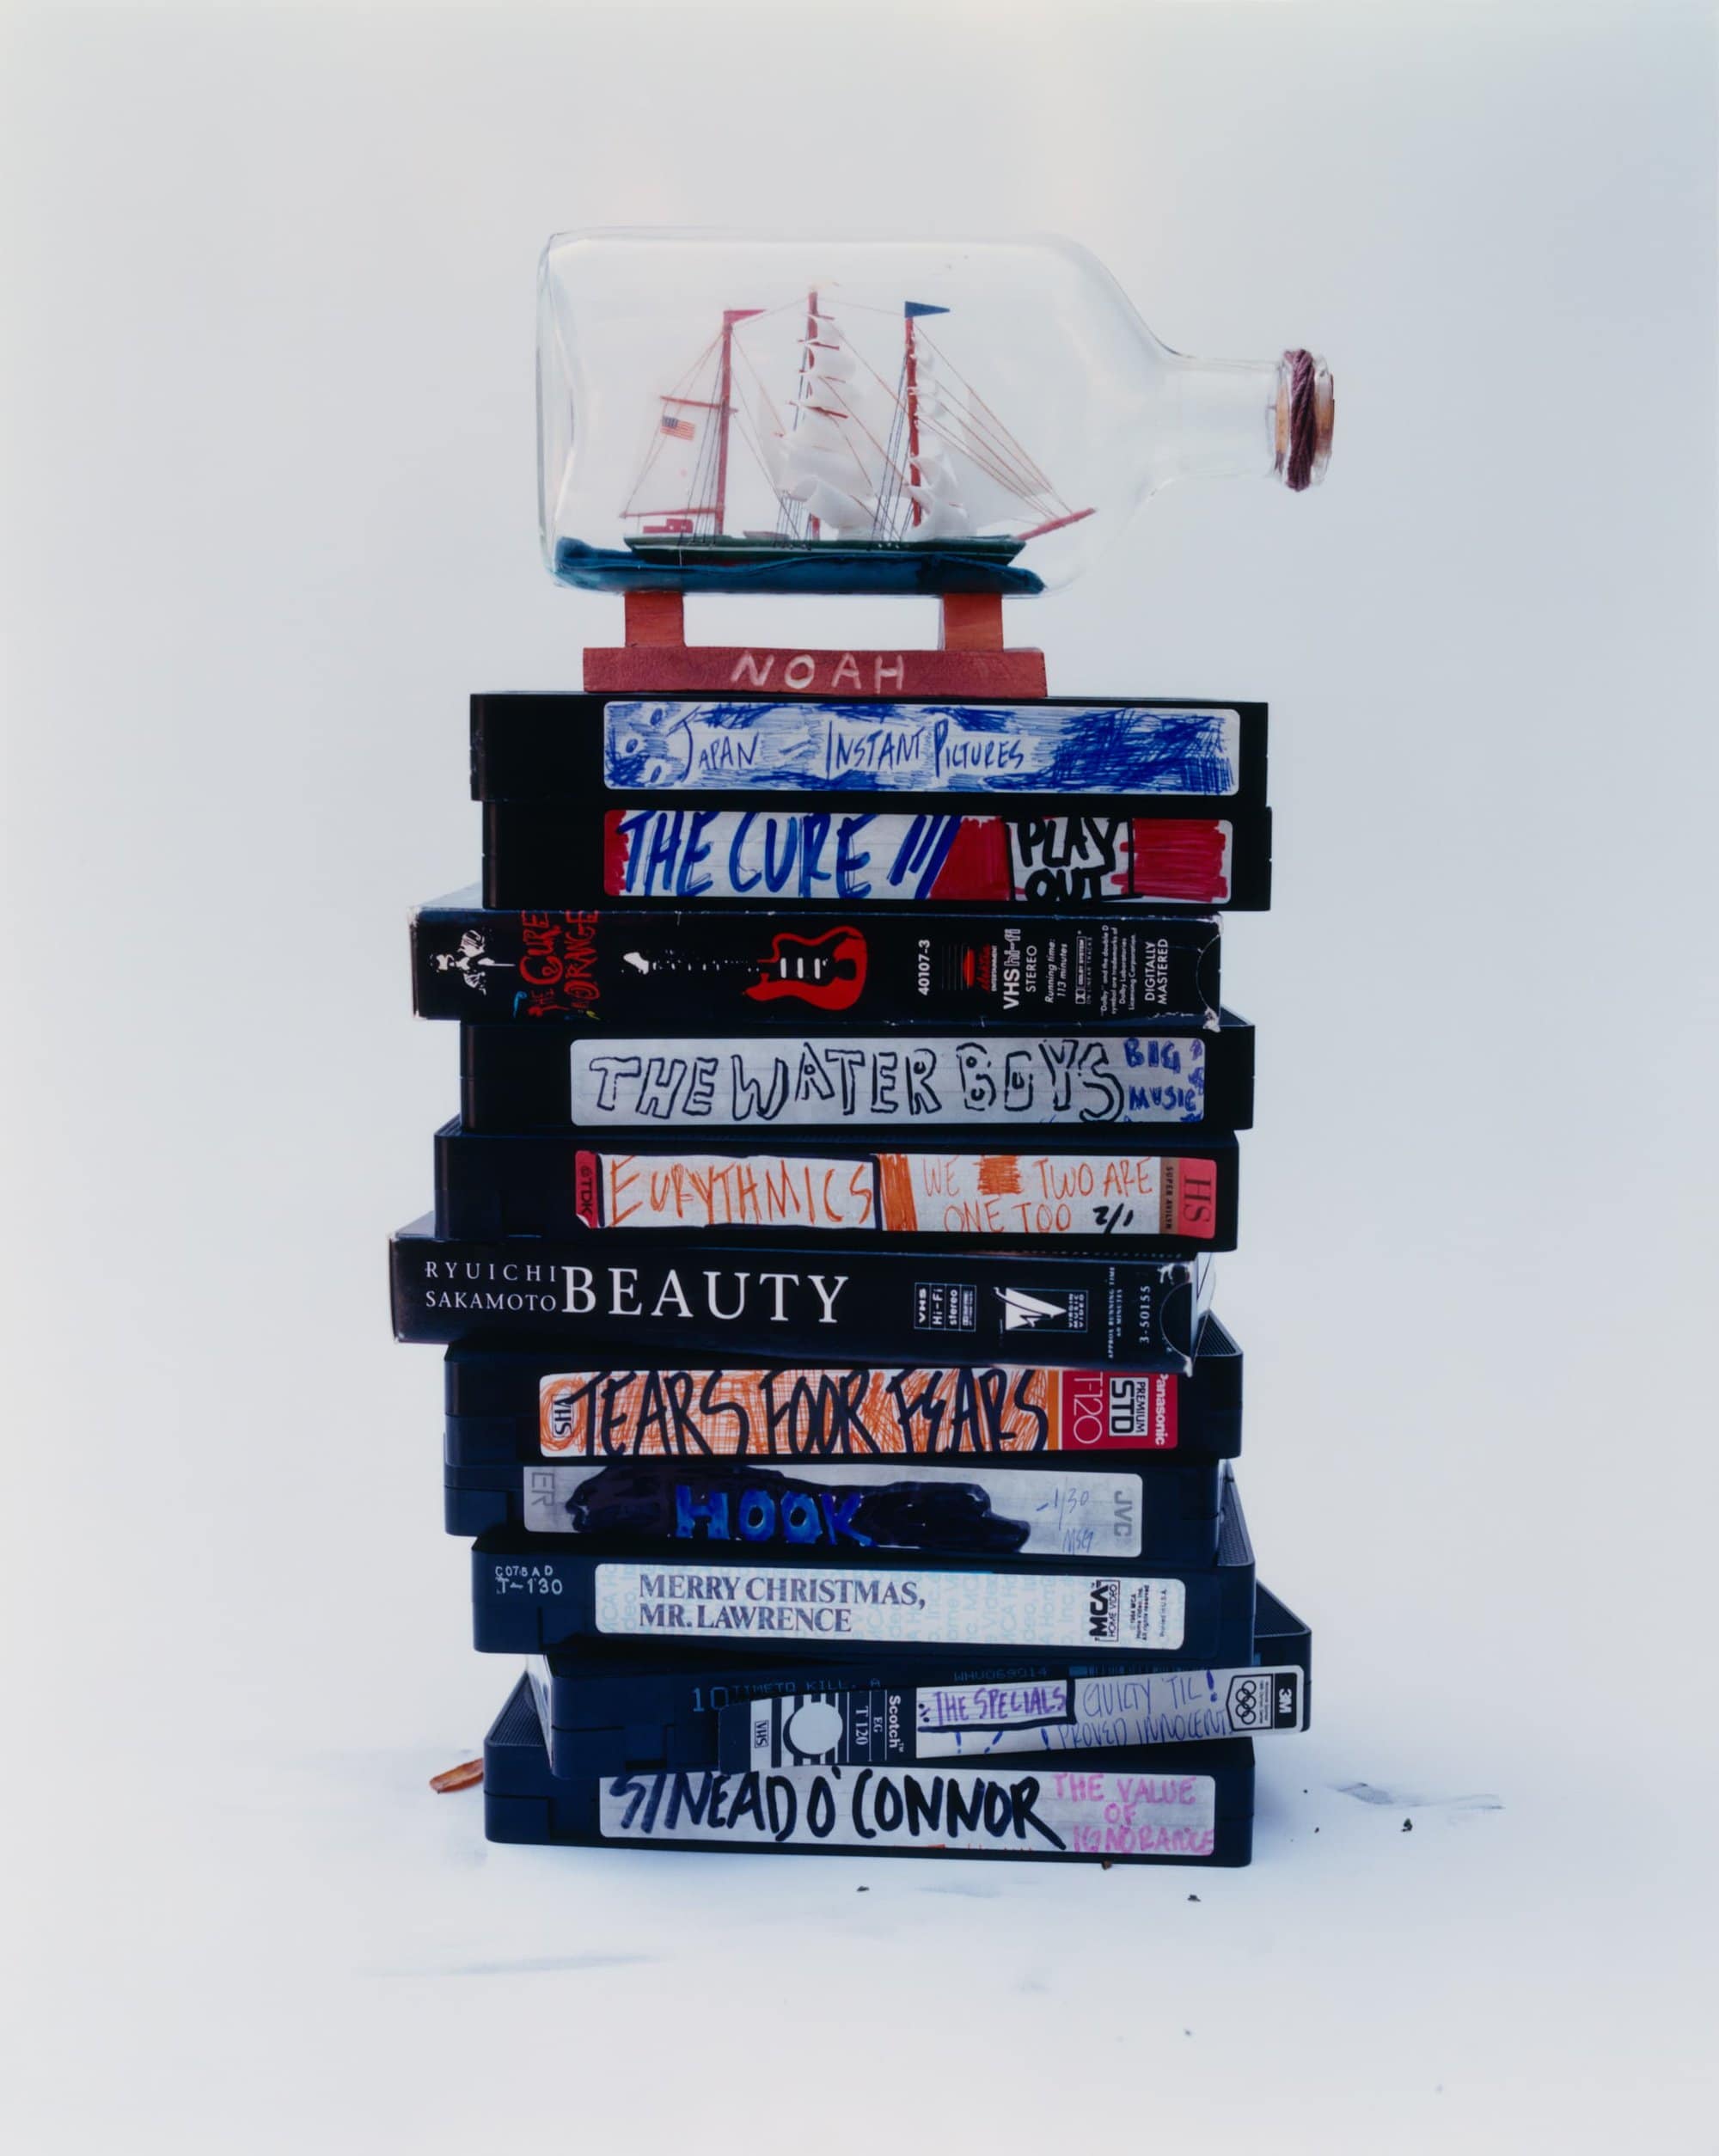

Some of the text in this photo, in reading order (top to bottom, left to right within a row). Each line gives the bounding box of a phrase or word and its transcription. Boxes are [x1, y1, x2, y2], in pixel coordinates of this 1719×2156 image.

[731, 651, 903, 695] NOAH
[826, 720, 926, 781] INSTANT
[933, 718, 1025, 778] PICTURES
[616, 810, 881, 898] THE CURE
[1015, 816, 1123, 873] PLAY
[1024, 867, 1110, 902] OUT
[918, 940, 931, 996] 40107-3
[1003, 969, 1020, 1010] VHS
[1025, 945, 1037, 993] STEREO
[1044, 965, 1058, 1003] Running
[1057, 943, 1068, 997] 113 minutes
[1145, 941, 1156, 1001] DIGITALLY
[1158, 939, 1168, 1005] MASTERED
[1123, 1038, 1181, 1074] BIG
[590, 1057, 719, 1119] THE
[1129, 1085, 1197, 1112] MUSIC
[581, 1178, 593, 1215] TDK
[922, 1156, 1153, 1200] WE TWO ARE
[1184, 1175, 1213, 1223] HS
[943, 1196, 1072, 1233] ONE TOO
[425, 1261, 556, 1283] RYUICHI
[560, 1265, 849, 1323] BEAUTY
[425, 1290, 557, 1312] SAKAMOTO
[932, 1289, 943, 1326] Hi-Fi
[948, 1289, 958, 1326] stereo
[1139, 1285, 1151, 1344] 3-50155
[554, 1397, 573, 1436] VHS
[555, 1370, 749, 1457] TEARS
[1074, 1371, 1104, 1444] T-120
[1111, 1380, 1135, 1434] STD
[1135, 1381, 1146, 1433] PREMIUM
[676, 1485, 877, 1547] HOOK
[1113, 1490, 1133, 1537] JVC
[639, 1574, 741, 1602] MERRY
[745, 1576, 927, 1610] CHRISTMAS,
[1089, 1584, 1109, 1637] MCA
[1109, 1583, 1117, 1609] VIDEO
[639, 1603, 693, 1628] MR.
[696, 1605, 852, 1632] LAWRENCE
[933, 1686, 1067, 1726] THE SPECIALS
[1083, 1678, 1152, 1718] GUILTY
[1279, 1687, 1293, 1713] 3M
[756, 1720, 768, 1748] VHS
[873, 1716, 883, 1733] EG
[889, 1694, 901, 1749] Scotch
[609, 1770, 798, 1842] SINEAD
[1052, 1773, 1196, 1805] THE VALUE
[1104, 1803, 1136, 1826] OF
